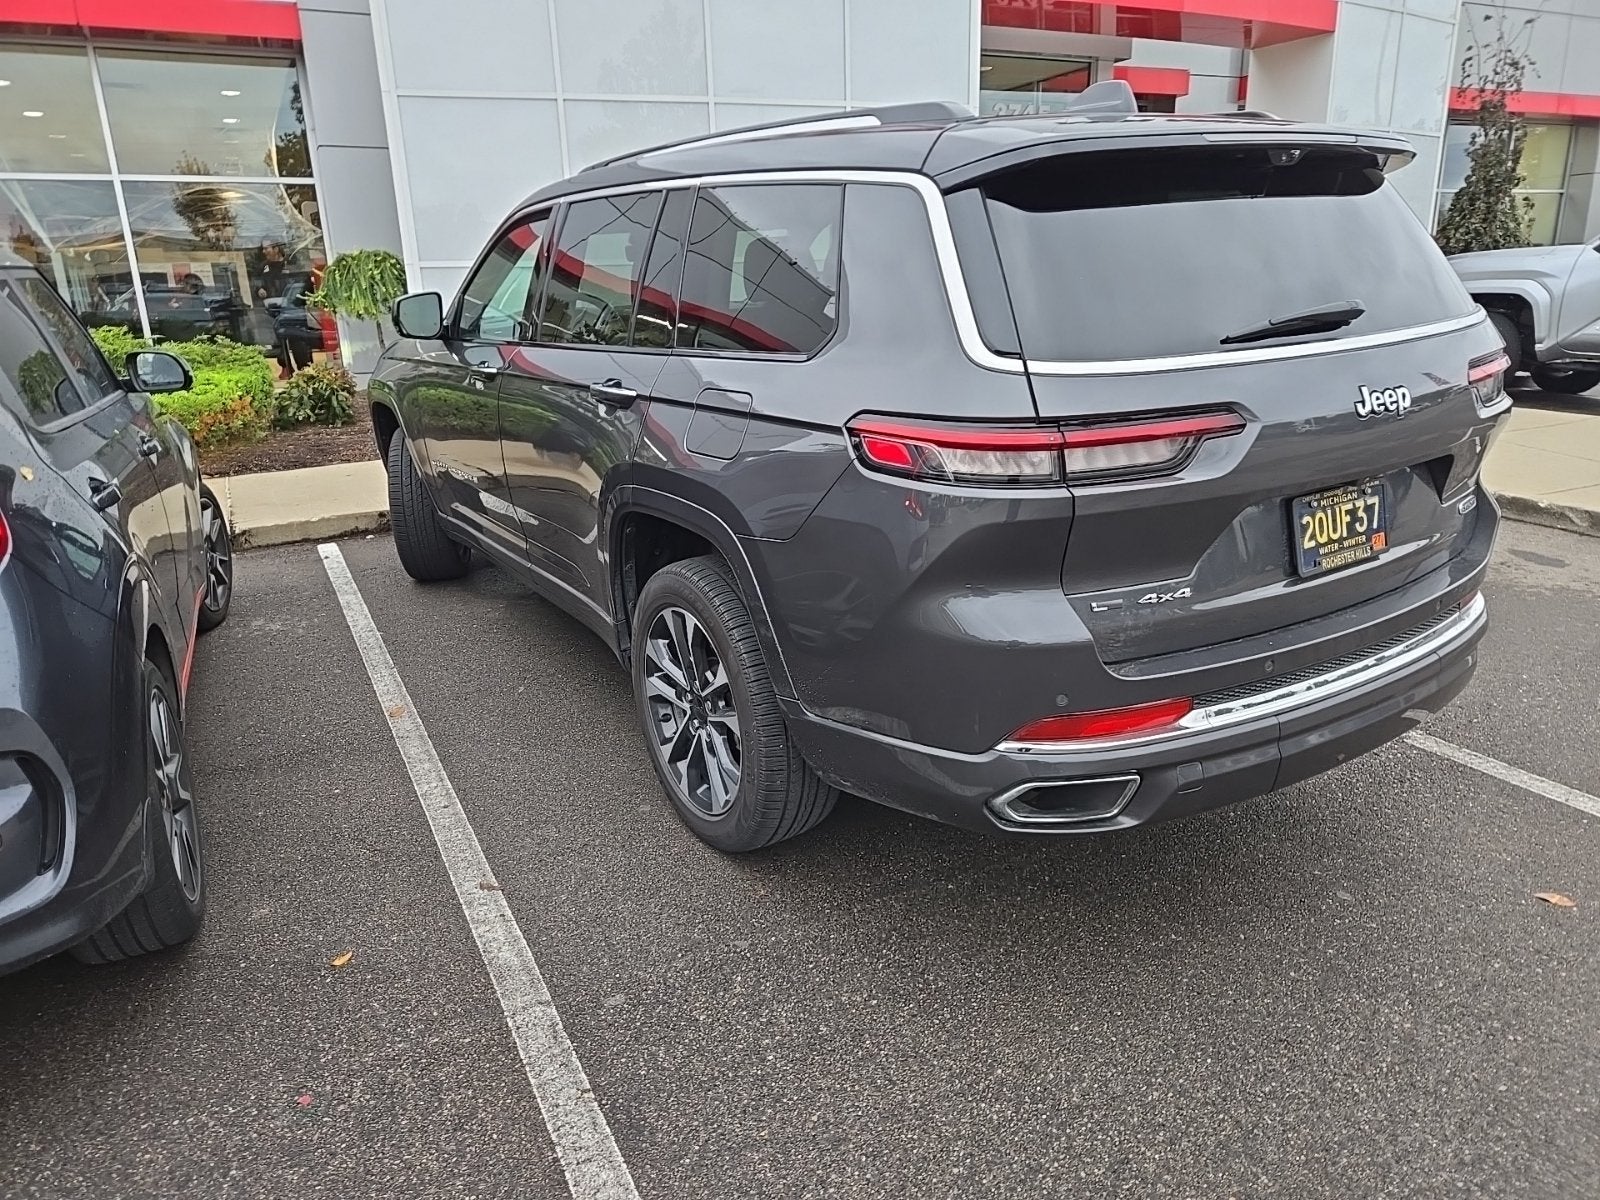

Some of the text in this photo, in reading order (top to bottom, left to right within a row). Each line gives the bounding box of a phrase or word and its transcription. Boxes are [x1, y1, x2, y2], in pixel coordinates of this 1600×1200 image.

[1354, 384, 1411, 418] Jeep
[1320, 491, 1358, 507] MICHIGAN
[1322, 546, 1371, 569] ROCHESTER HILLS
[1137, 587, 1192, 605] 4x4
